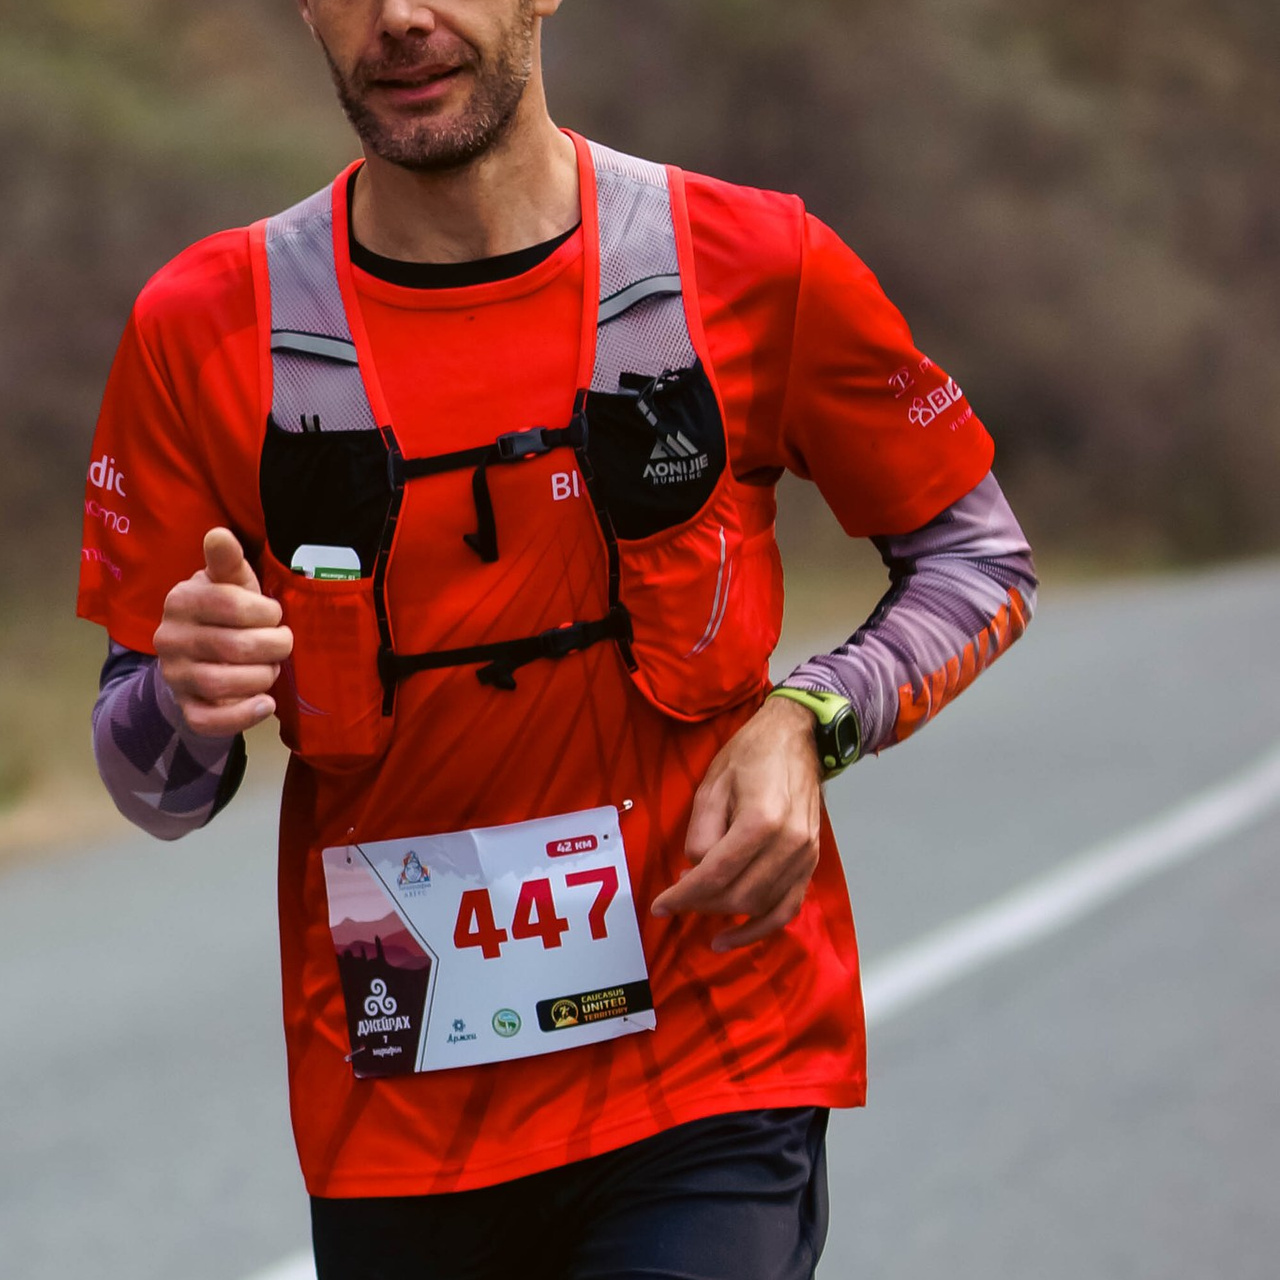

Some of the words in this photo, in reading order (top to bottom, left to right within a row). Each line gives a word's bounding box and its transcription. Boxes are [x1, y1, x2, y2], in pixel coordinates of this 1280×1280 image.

[643, 453, 708, 478] AONIJIE
[87, 455, 126, 497] dic
[653, 470, 702, 485] RUNNING
[557, 841, 572, 852] 42
[453, 866, 620, 960] 447
[581, 988, 625, 1003] CAUCASUS
[582, 996, 627, 1014] UNITED
[584, 1007, 628, 1022] TERRITORY
[357, 1015, 411, 1037] ДЖЕЙРАХ
